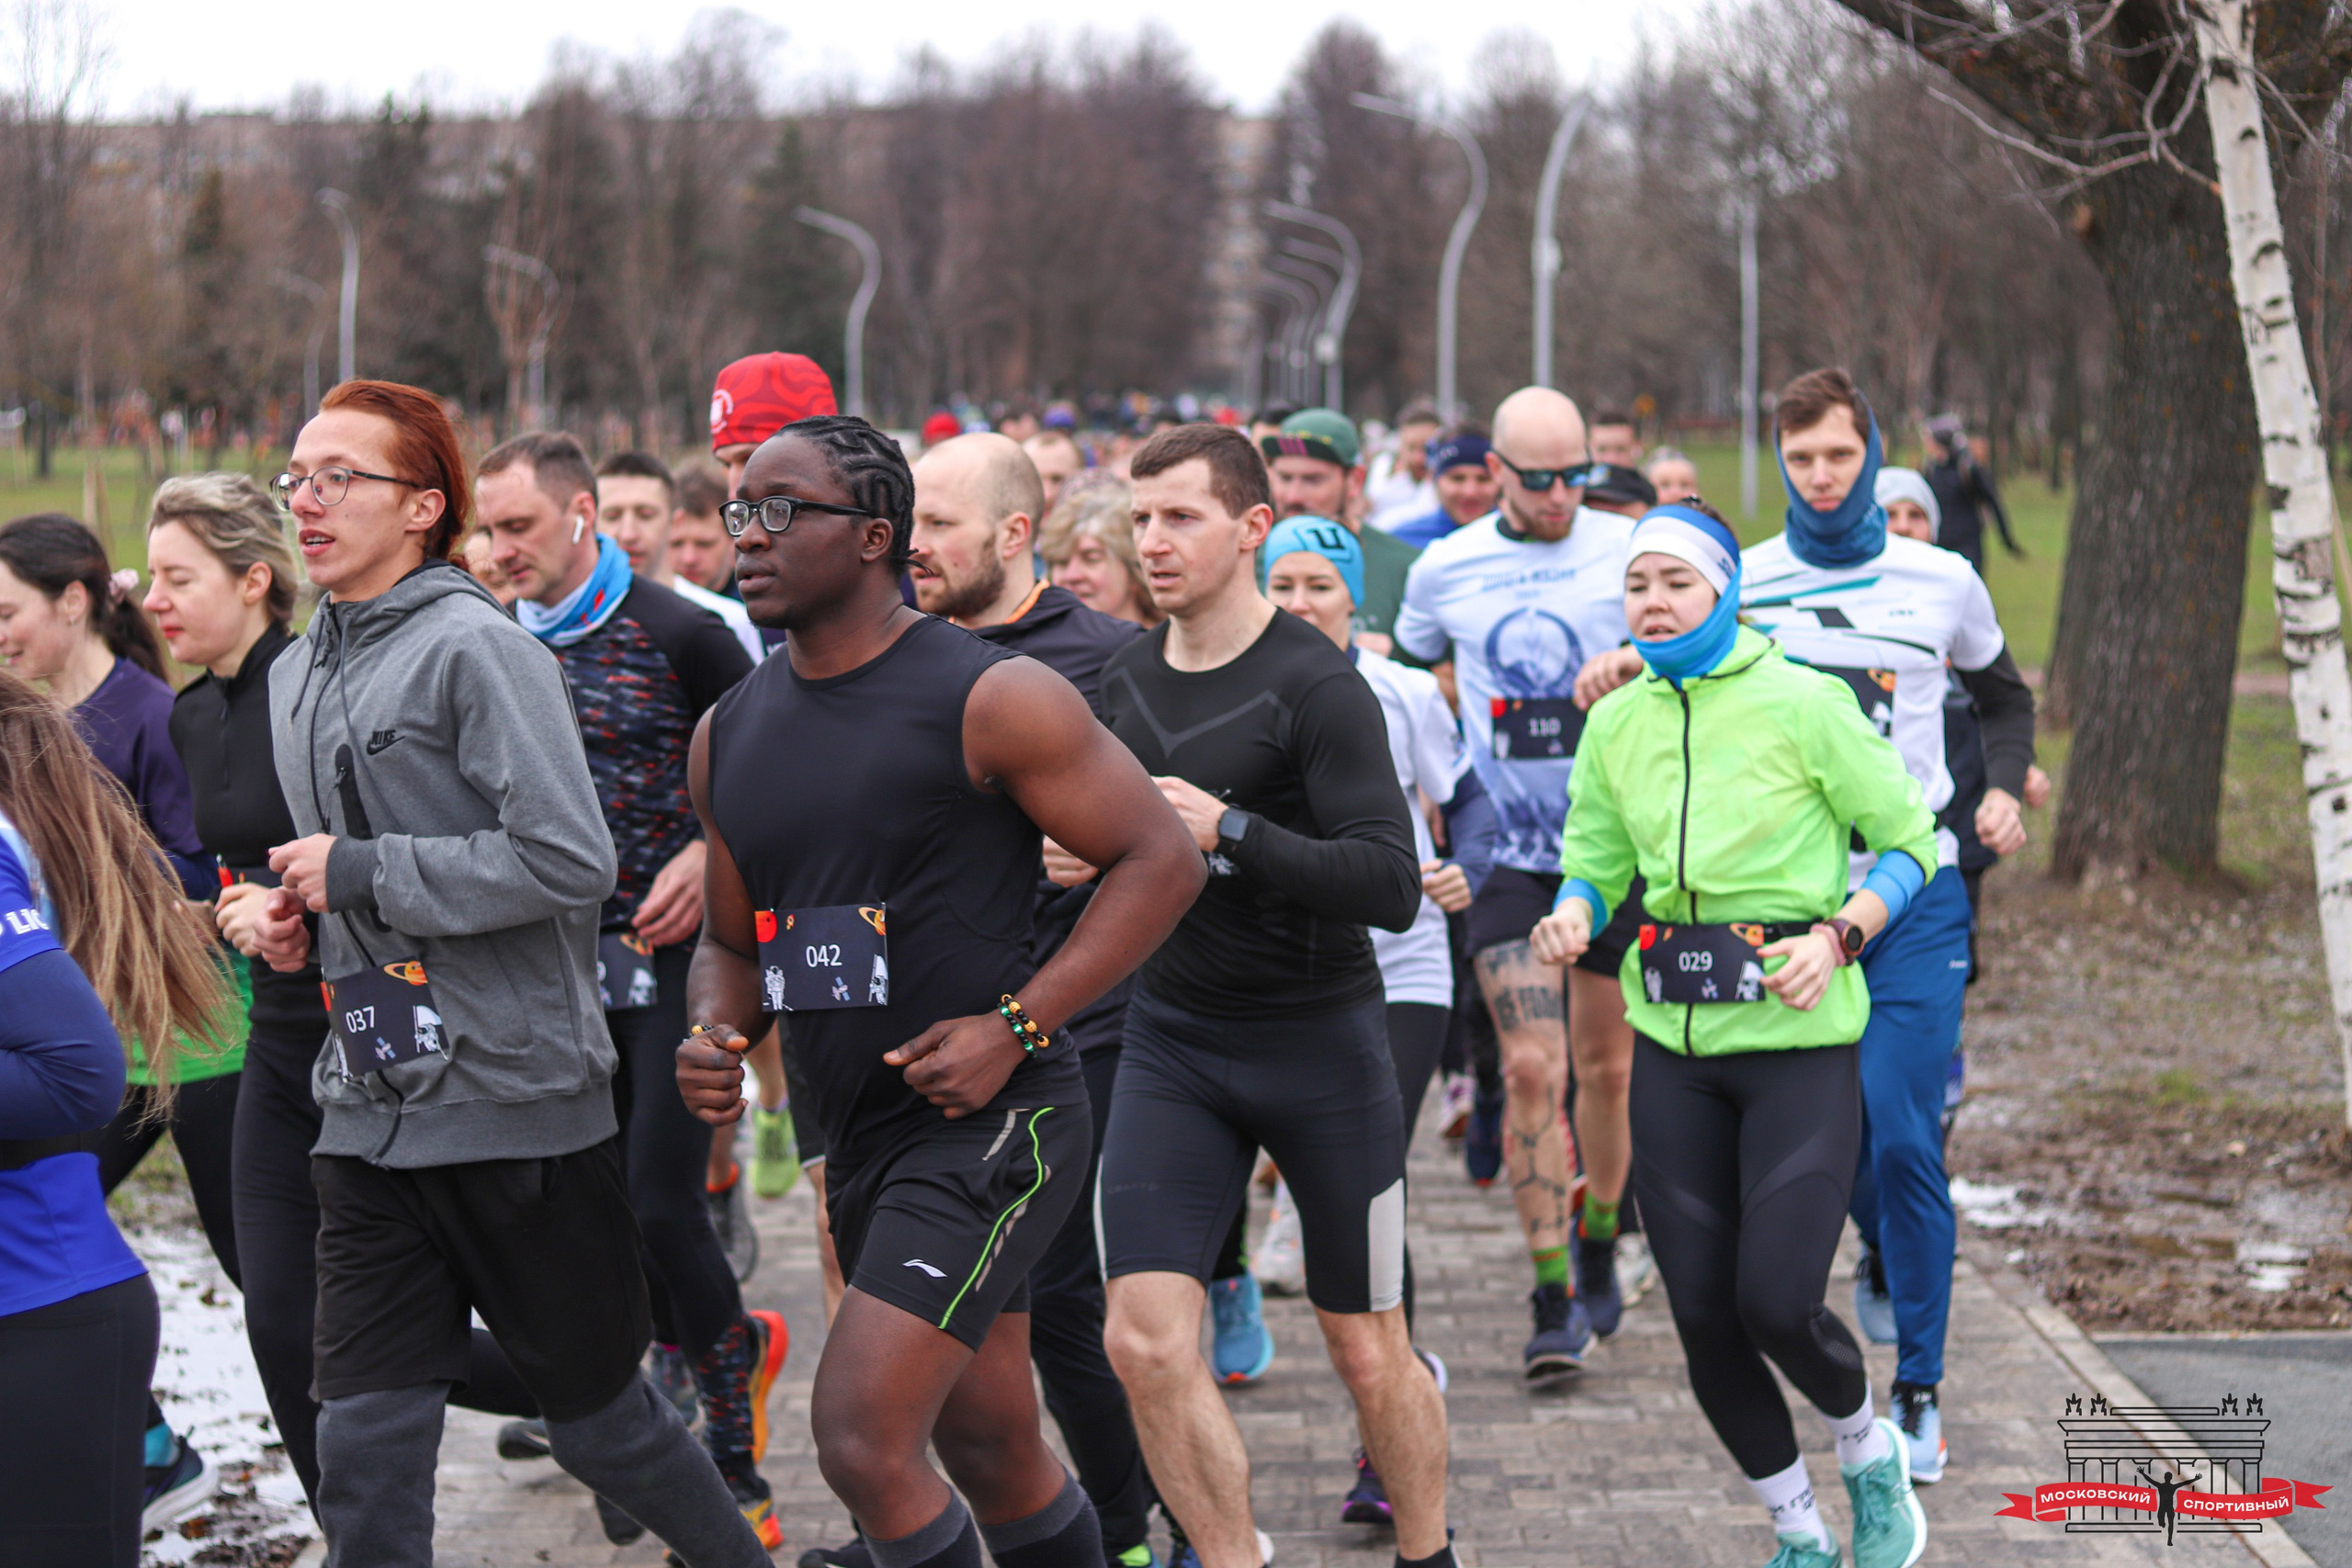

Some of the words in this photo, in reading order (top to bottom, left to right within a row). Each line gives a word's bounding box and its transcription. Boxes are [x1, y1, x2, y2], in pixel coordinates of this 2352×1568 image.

[371, 729, 396, 745] NIKE
[1529, 717, 1561, 737] 110
[806, 943, 842, 968] 042
[1679, 951, 1713, 972] 029
[345, 1005, 375, 1033] 037
